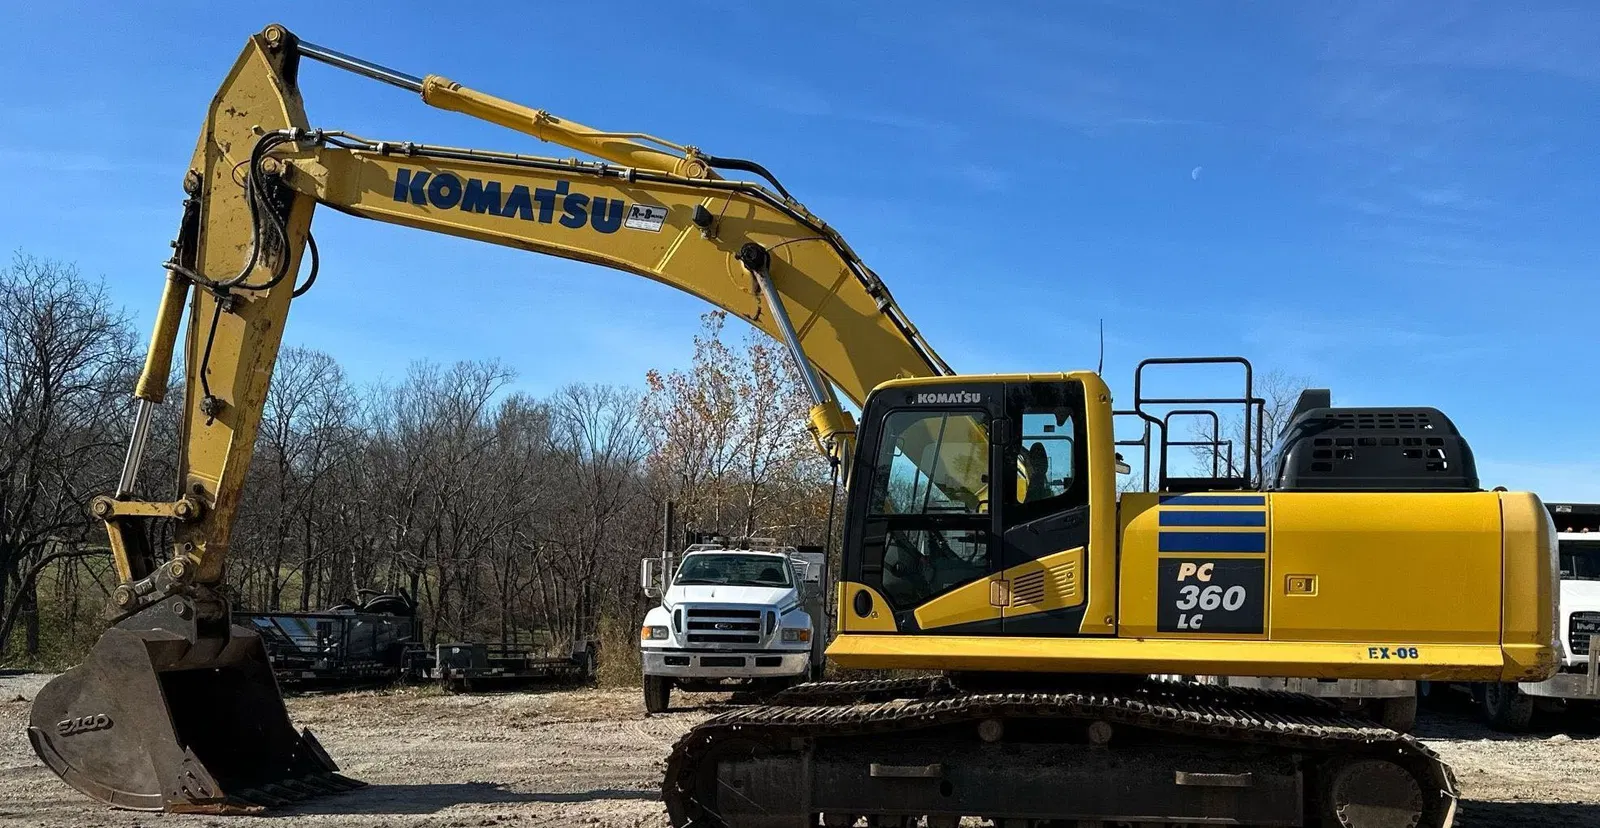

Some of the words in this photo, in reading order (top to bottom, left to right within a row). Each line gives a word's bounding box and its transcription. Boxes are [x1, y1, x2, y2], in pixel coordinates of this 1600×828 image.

[393, 168, 625, 233] KOMATSU
[917, 390, 980, 403] KOMATSU
[1177, 563, 1214, 582] PC
[1176, 585, 1246, 611] 360
[1177, 614, 1203, 629] LC
[1368, 647, 1419, 659] EX-08
